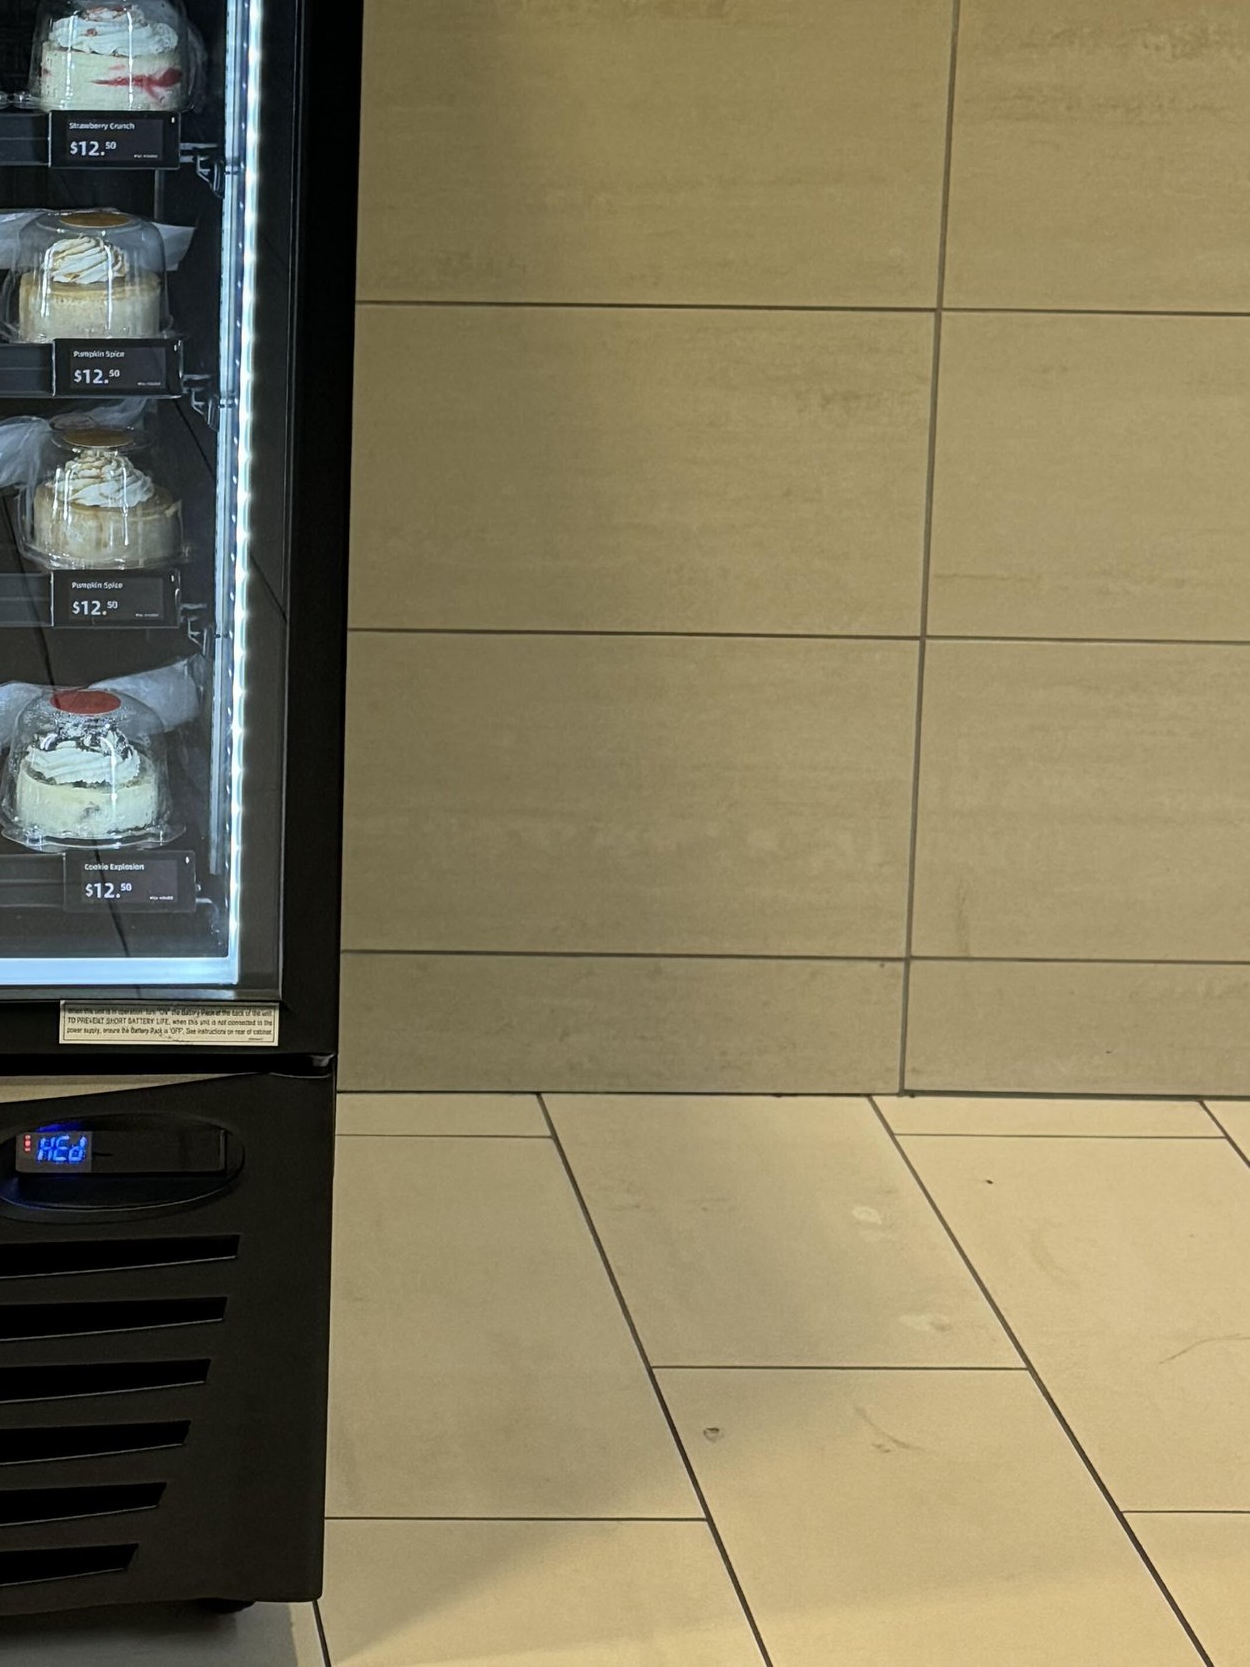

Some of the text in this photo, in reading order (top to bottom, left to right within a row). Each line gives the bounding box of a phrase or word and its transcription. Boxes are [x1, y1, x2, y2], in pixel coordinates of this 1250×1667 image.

[69, 122, 134, 131] Strawberry Crunch
[77, 1017, 104, 1025] PREVENT
[106, 1017, 126, 1025] SHORT
